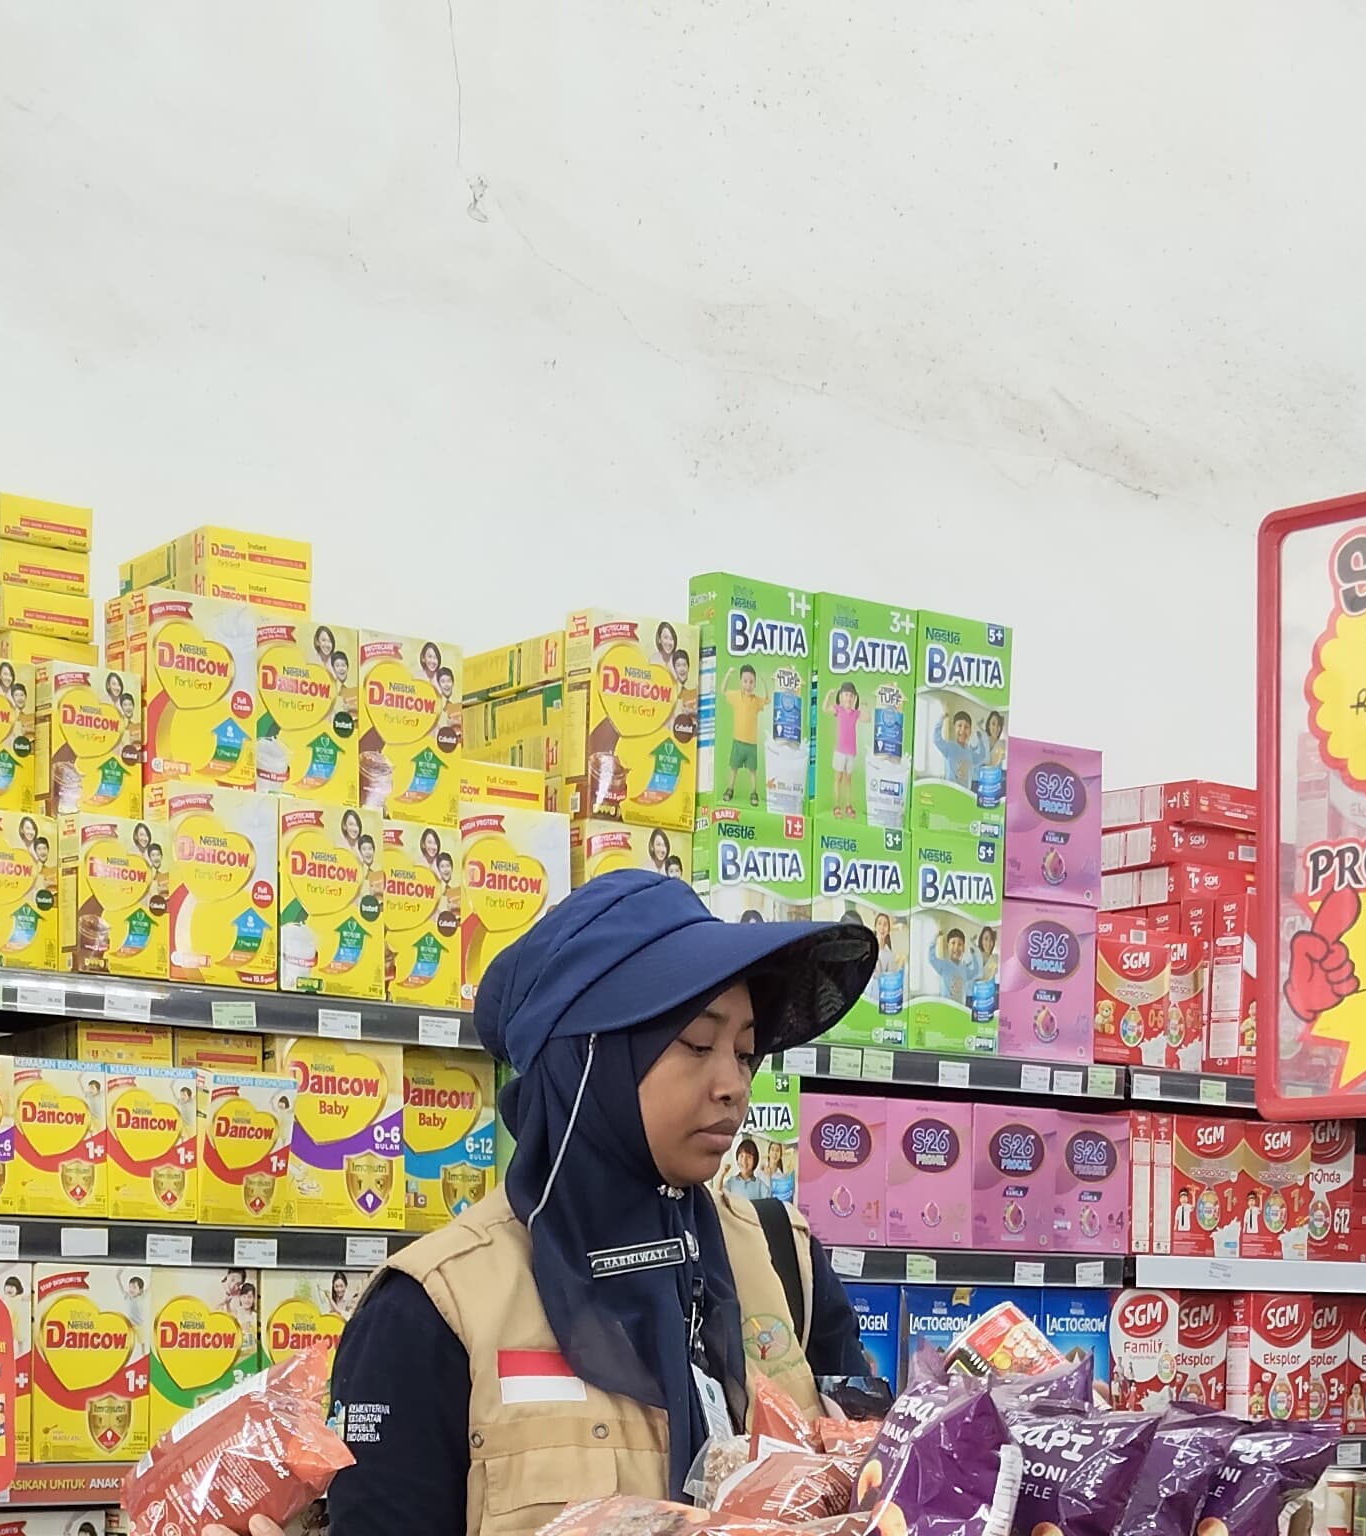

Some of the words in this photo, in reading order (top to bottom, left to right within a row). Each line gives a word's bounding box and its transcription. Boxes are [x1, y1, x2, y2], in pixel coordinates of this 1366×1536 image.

[787, 591, 812, 618] 1+
[889, 611, 915, 634] 3+
[730, 613, 807, 656] BATITA
[833, 631, 909, 676] BATITA
[927, 648, 1004, 689] BATITA
[1038, 800, 1074, 815] PROCAL
[721, 843, 803, 883] BATITA
[1121, 949, 1152, 971] SGM
[15, 1056, 55, 1070] KEMASAN
[57, 1060, 104, 1072] EKONOMIS
[319, 1100, 349, 1120] Baby
[1196, 1125, 1225, 1146] SGM
[374, 1142, 401, 1152] BULAN
[1046, 1312, 1106, 1336] LACTOGROW
[1123, 1302, 1163, 1328] SGM
[1266, 1303, 1299, 1330] SGM
[1263, 1354, 1301, 1367] Eksplor
[348, 1404, 391, 1415] KEMENTERIAN
[348, 1414, 382, 1424] KESEHATAN
[346, 1432, 380, 1442] INDONESIA
[347, 1423, 376, 1433] REPUBLIK
[50, 1480, 85, 1490] UNTUK
[90, 1478, 119, 1489] ANAK
